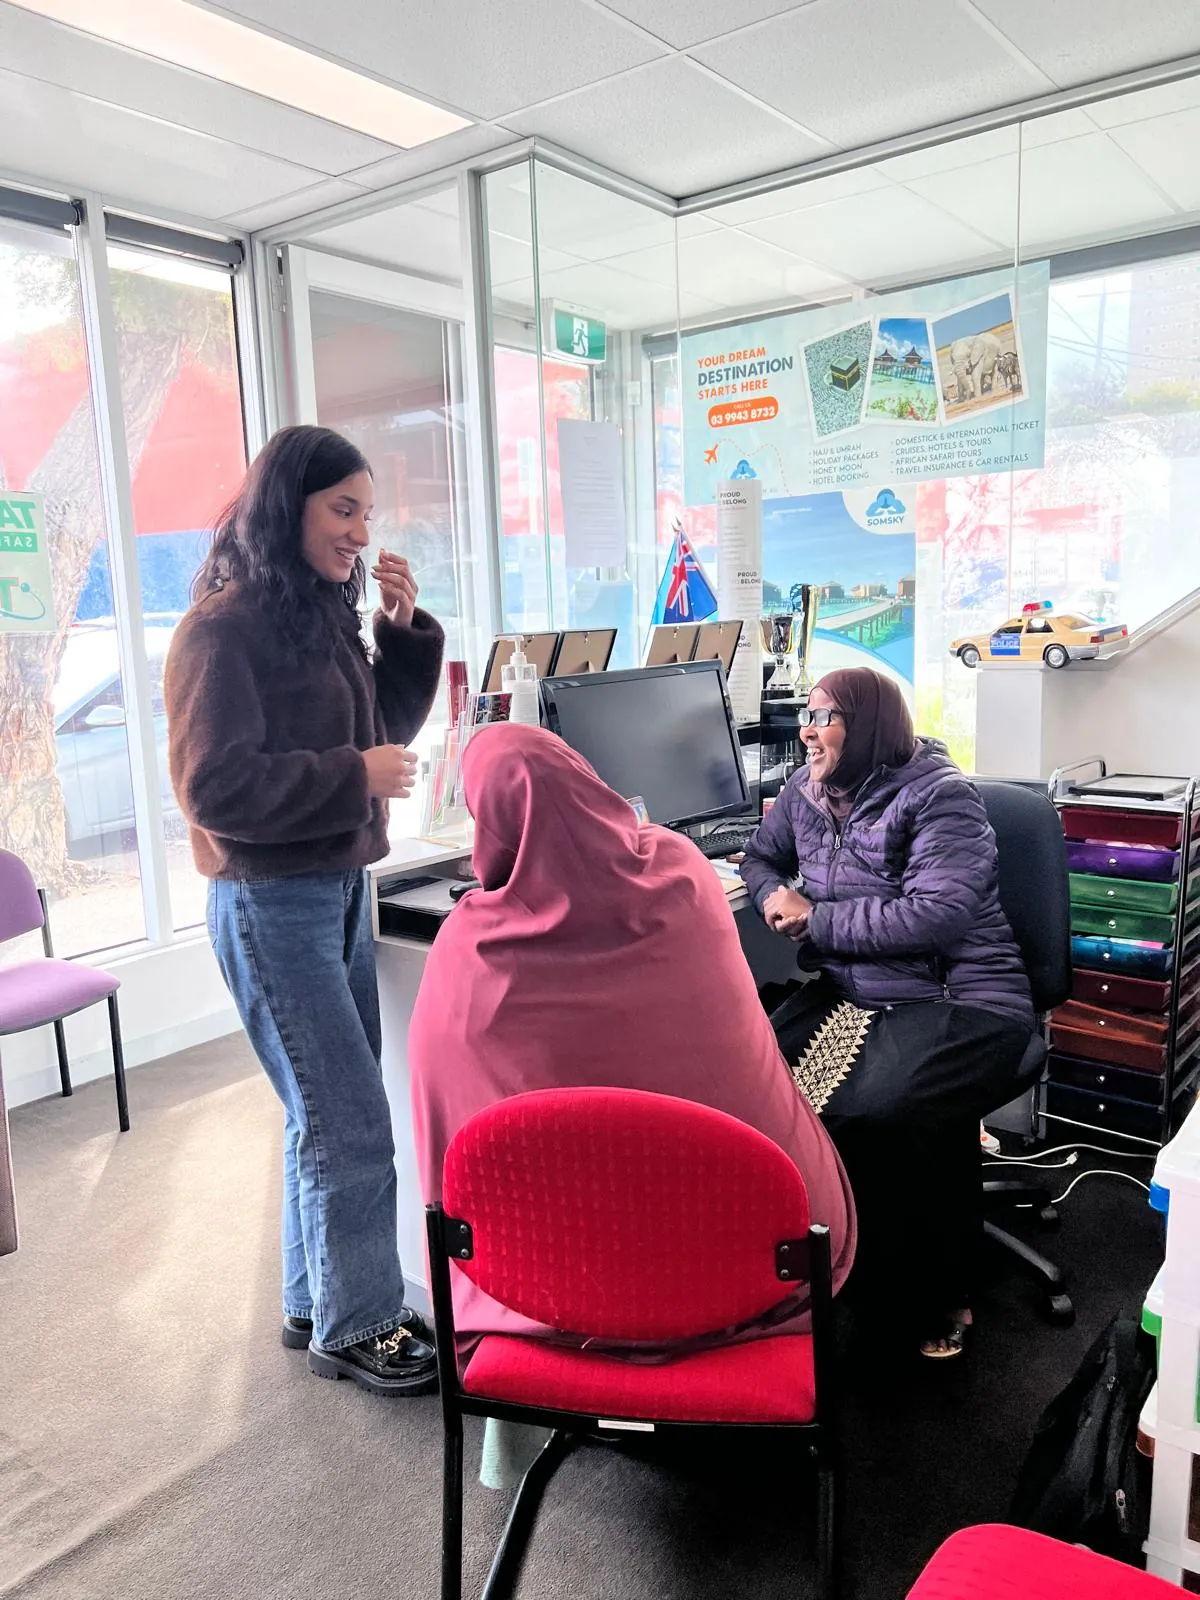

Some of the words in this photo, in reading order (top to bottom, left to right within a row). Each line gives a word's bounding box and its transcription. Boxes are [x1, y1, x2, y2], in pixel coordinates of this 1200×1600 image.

[697, 355, 725, 369] YOUR
[729, 347, 766, 363] DREAM
[698, 356, 793, 386] DESTINATION
[698, 383, 737, 400] STARTS
[741, 379, 768, 393] HERE
[711, 412, 723, 425] 03
[724, 409, 748, 423] 9943
[750, 406, 775, 419] 8732
[896, 434, 938, 446] DOMESTICK
[947, 424, 1009, 440] INTERNATIONAL
[1012, 420, 1039, 431] TICKET
[928, 441, 957, 452] HOTELS
[967, 437, 992, 447] TOURS
[813, 456, 841, 465] HOLIDAY
[843, 451, 879, 461] PACKAGES
[896, 455, 927, 465] AFRICAN
[929, 451, 954, 462] SAFARI
[957, 448, 982, 459] TOURS
[896, 465, 921, 475] TRAVEL
[923, 460, 966, 472] INSURANCE
[976, 458, 992, 466] CAR
[993, 453, 1029, 464] RENTALS
[813, 466, 836, 475] HONEY
[840, 463, 863, 471] MOON
[813, 475, 835, 485] HOTEL
[836, 471, 869, 483] BOOKING
[867, 515, 905, 527] SOMSKY
